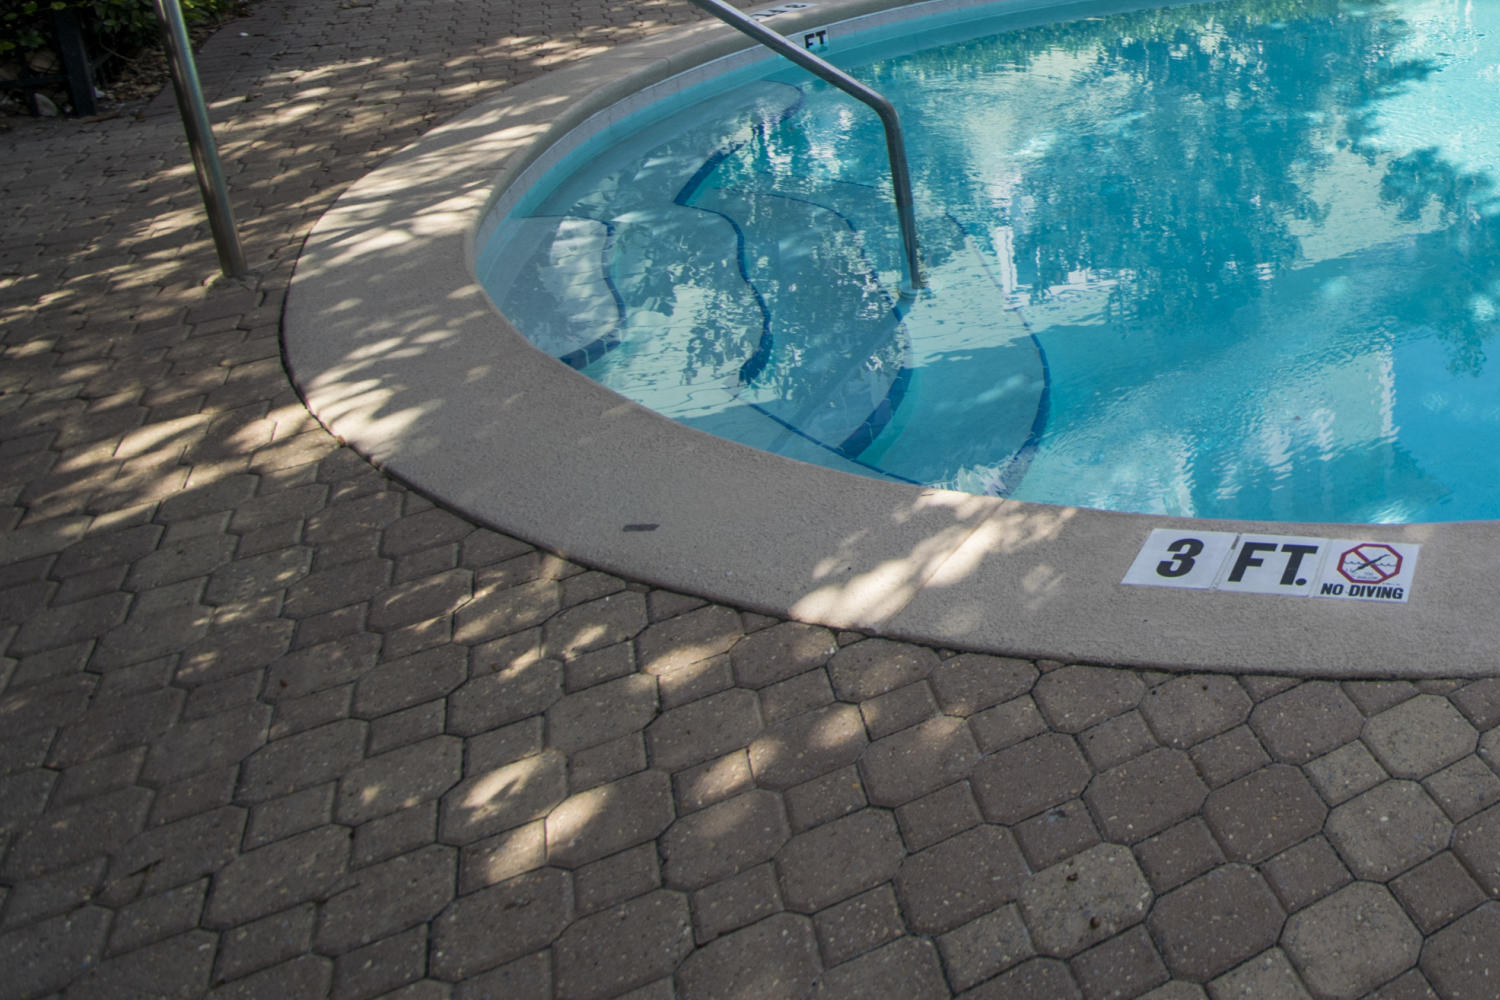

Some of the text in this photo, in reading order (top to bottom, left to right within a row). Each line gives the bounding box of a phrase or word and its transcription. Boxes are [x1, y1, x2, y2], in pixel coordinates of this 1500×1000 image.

[804, 29, 826, 49] FT
[1156, 538, 1319, 586] 3 FT.
[1320, 582, 1404, 600] NO DIVING
